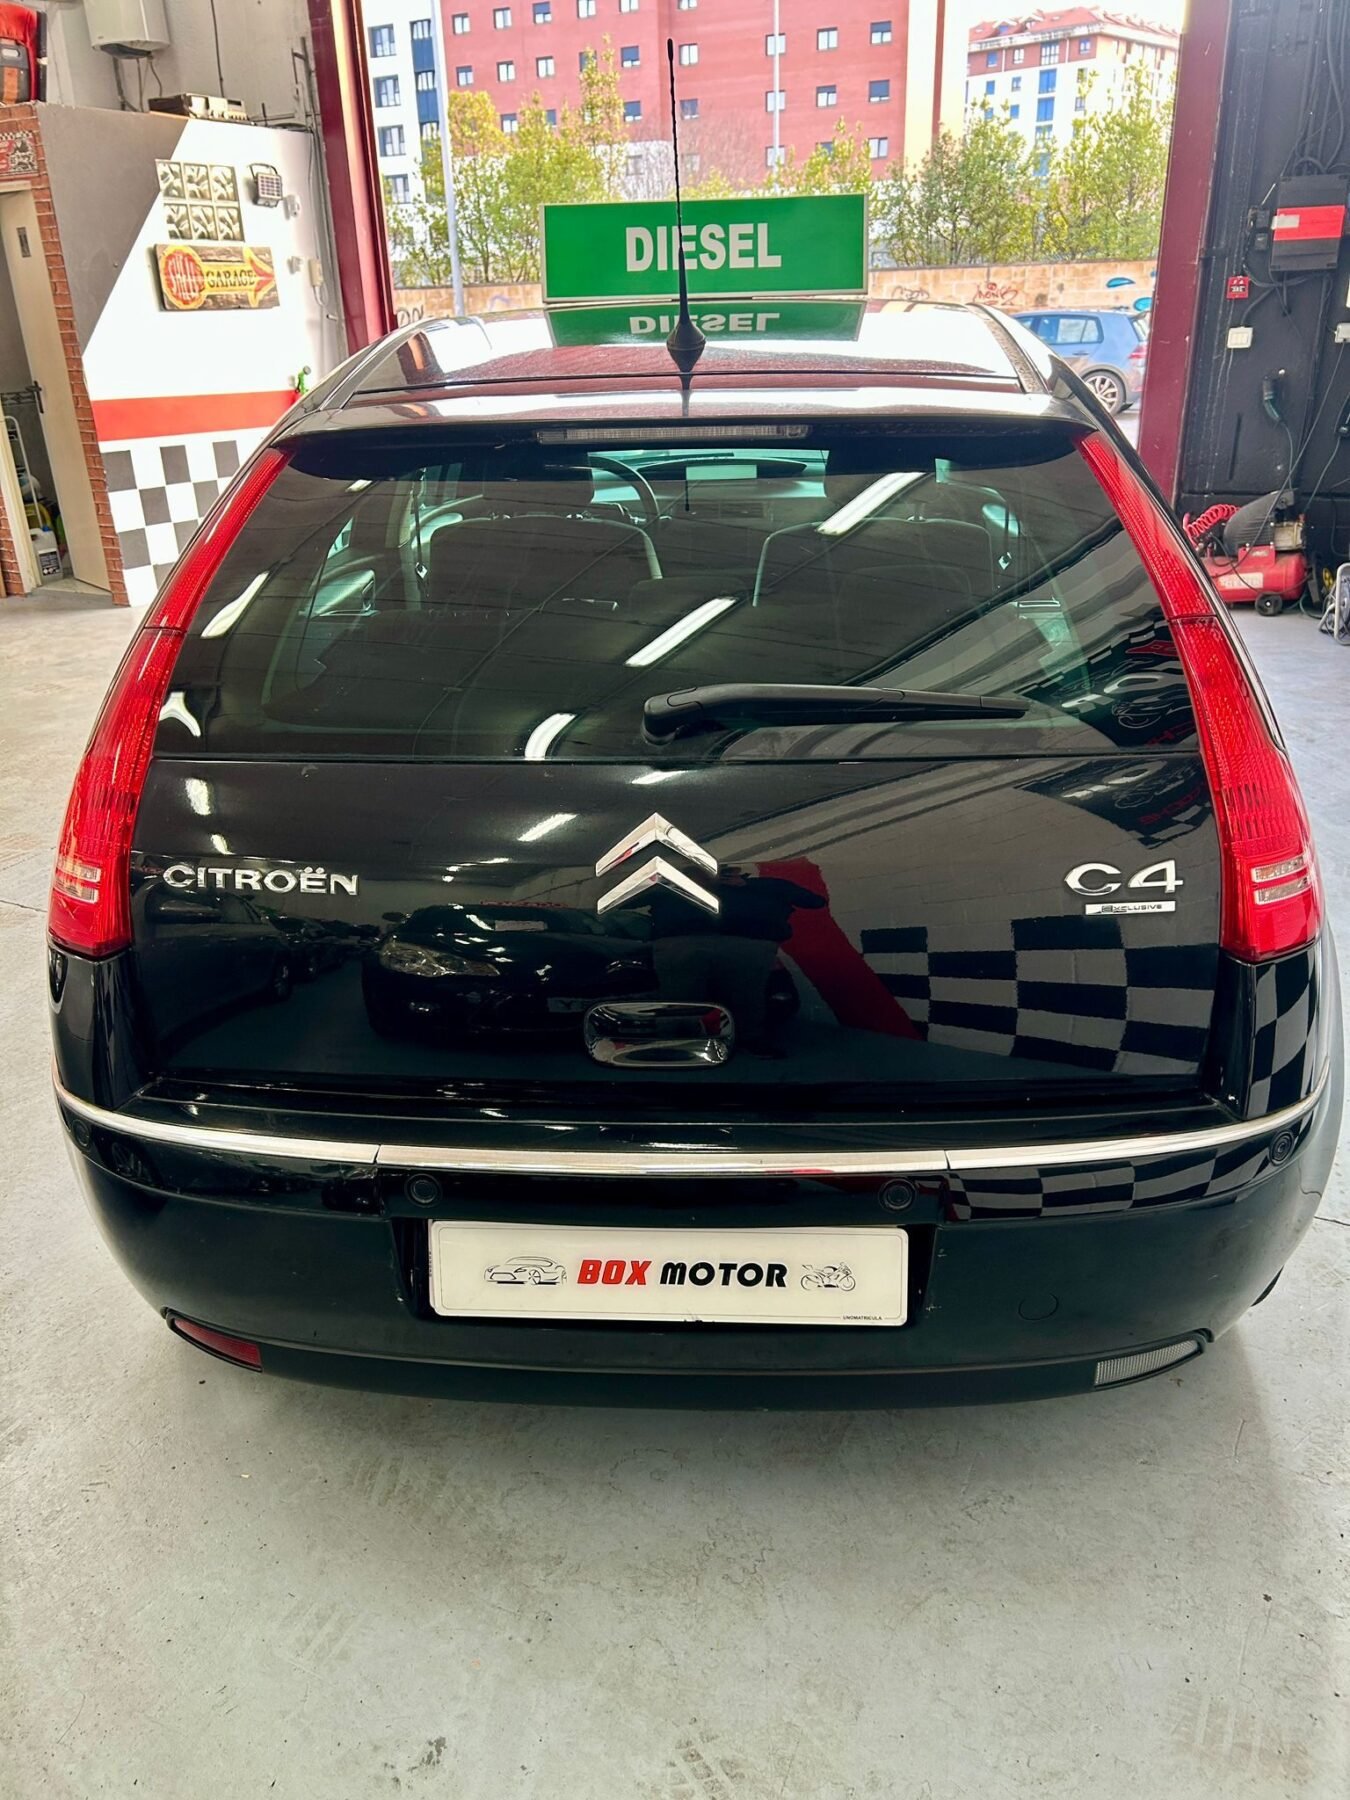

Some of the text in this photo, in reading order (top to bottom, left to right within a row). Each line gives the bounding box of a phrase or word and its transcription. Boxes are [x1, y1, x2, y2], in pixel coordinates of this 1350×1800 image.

[626, 222, 782, 272] DIESEL
[206, 269, 255, 288] GARAGE
[162, 865, 359, 896] CITROËN
[1064, 859, 1184, 896] C4
[1101, 904, 1163, 913] EXCLUSIVE
[577, 1259, 788, 1288] BOX MOTOR
